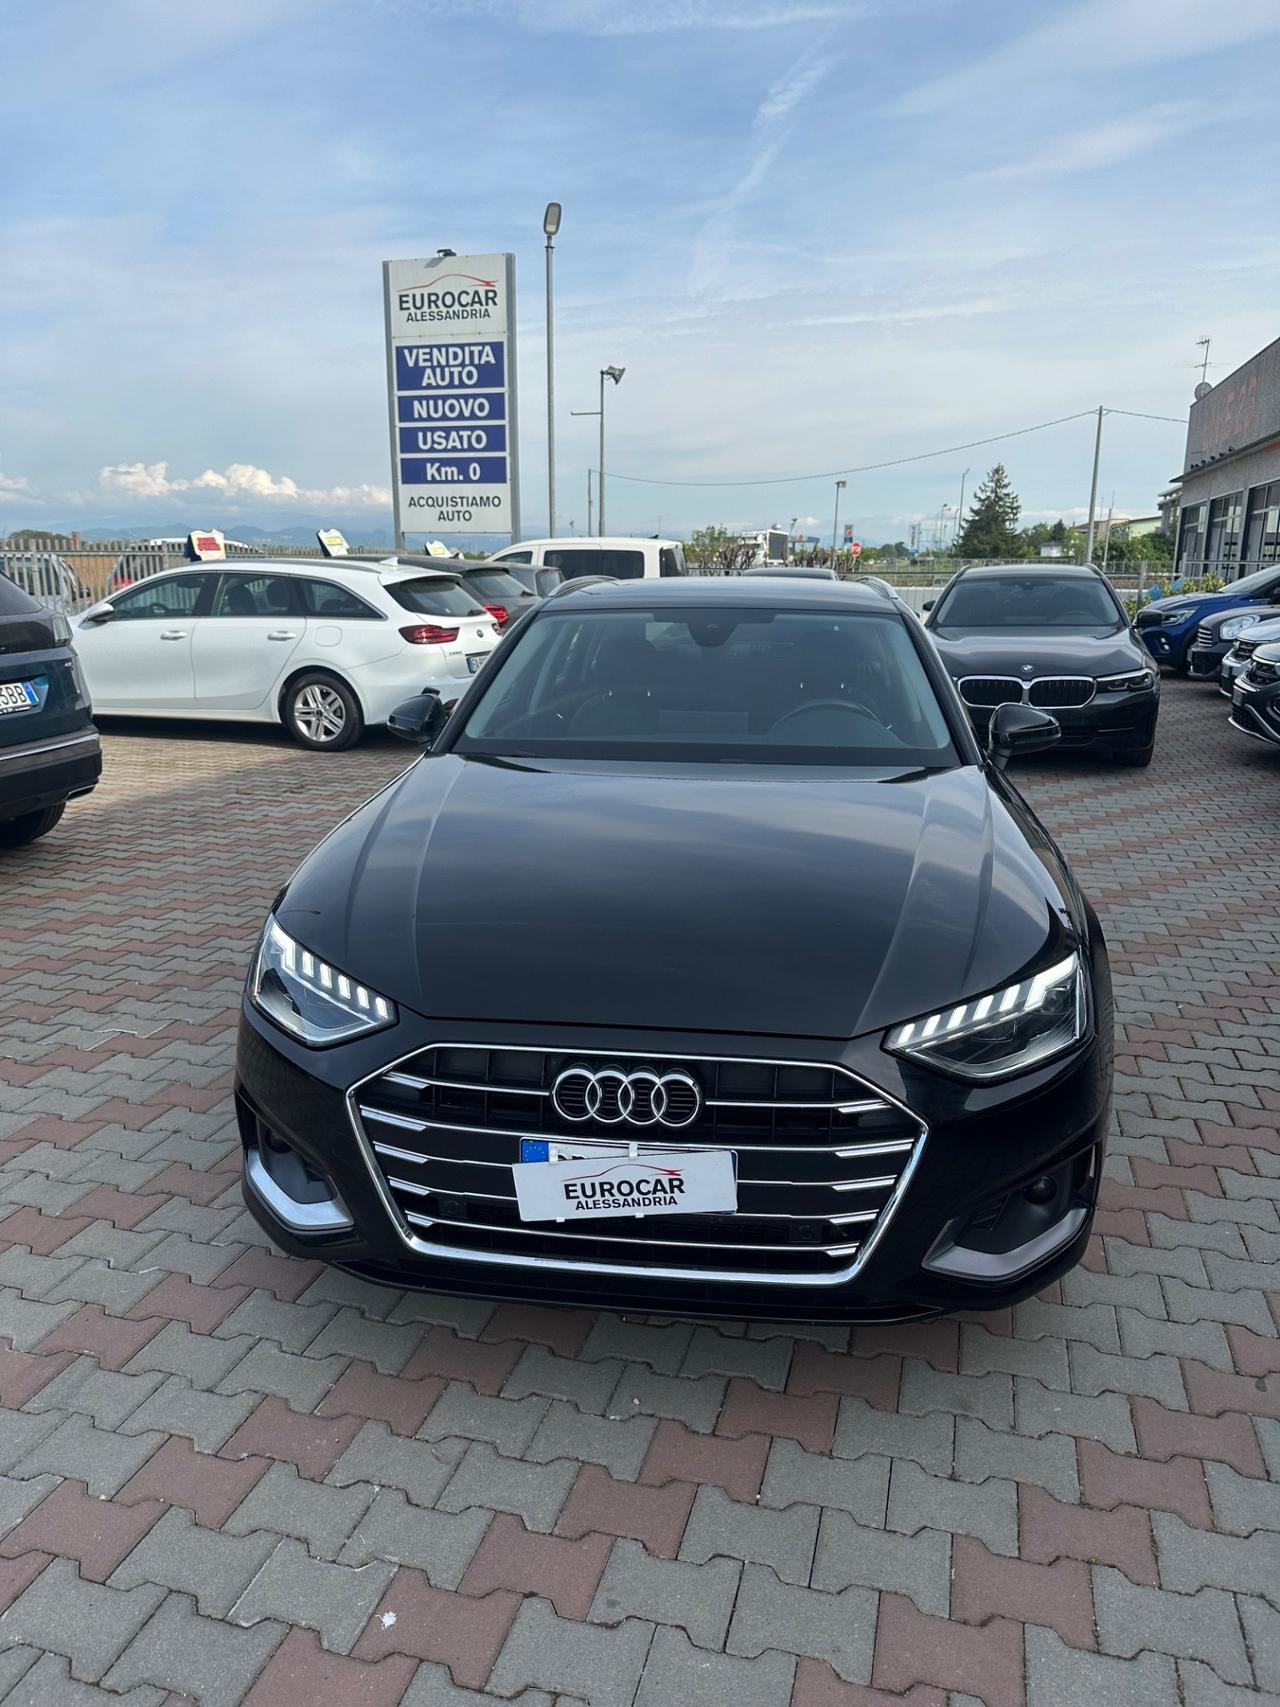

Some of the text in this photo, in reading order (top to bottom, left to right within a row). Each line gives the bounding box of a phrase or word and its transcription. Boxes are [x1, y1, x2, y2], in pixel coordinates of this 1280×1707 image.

[398, 289, 498, 311] EUROCAR
[406, 308, 491, 323] ALESSANDRIA
[403, 345, 496, 367] VENDITA
[421, 366, 478, 386] AUTO
[413, 398, 490, 418] NUOVO
[418, 430, 487, 450] USATO
[426, 462, 481, 481] Km. 0
[408, 496, 502, 509] ACQUISTIAMO
[437, 510, 472, 522] AUTO
[0, 685, 27, 706] 3BB
[564, 1177, 685, 1200] EUROCAR
[575, 1195, 678, 1211] ALESSANDRIA
